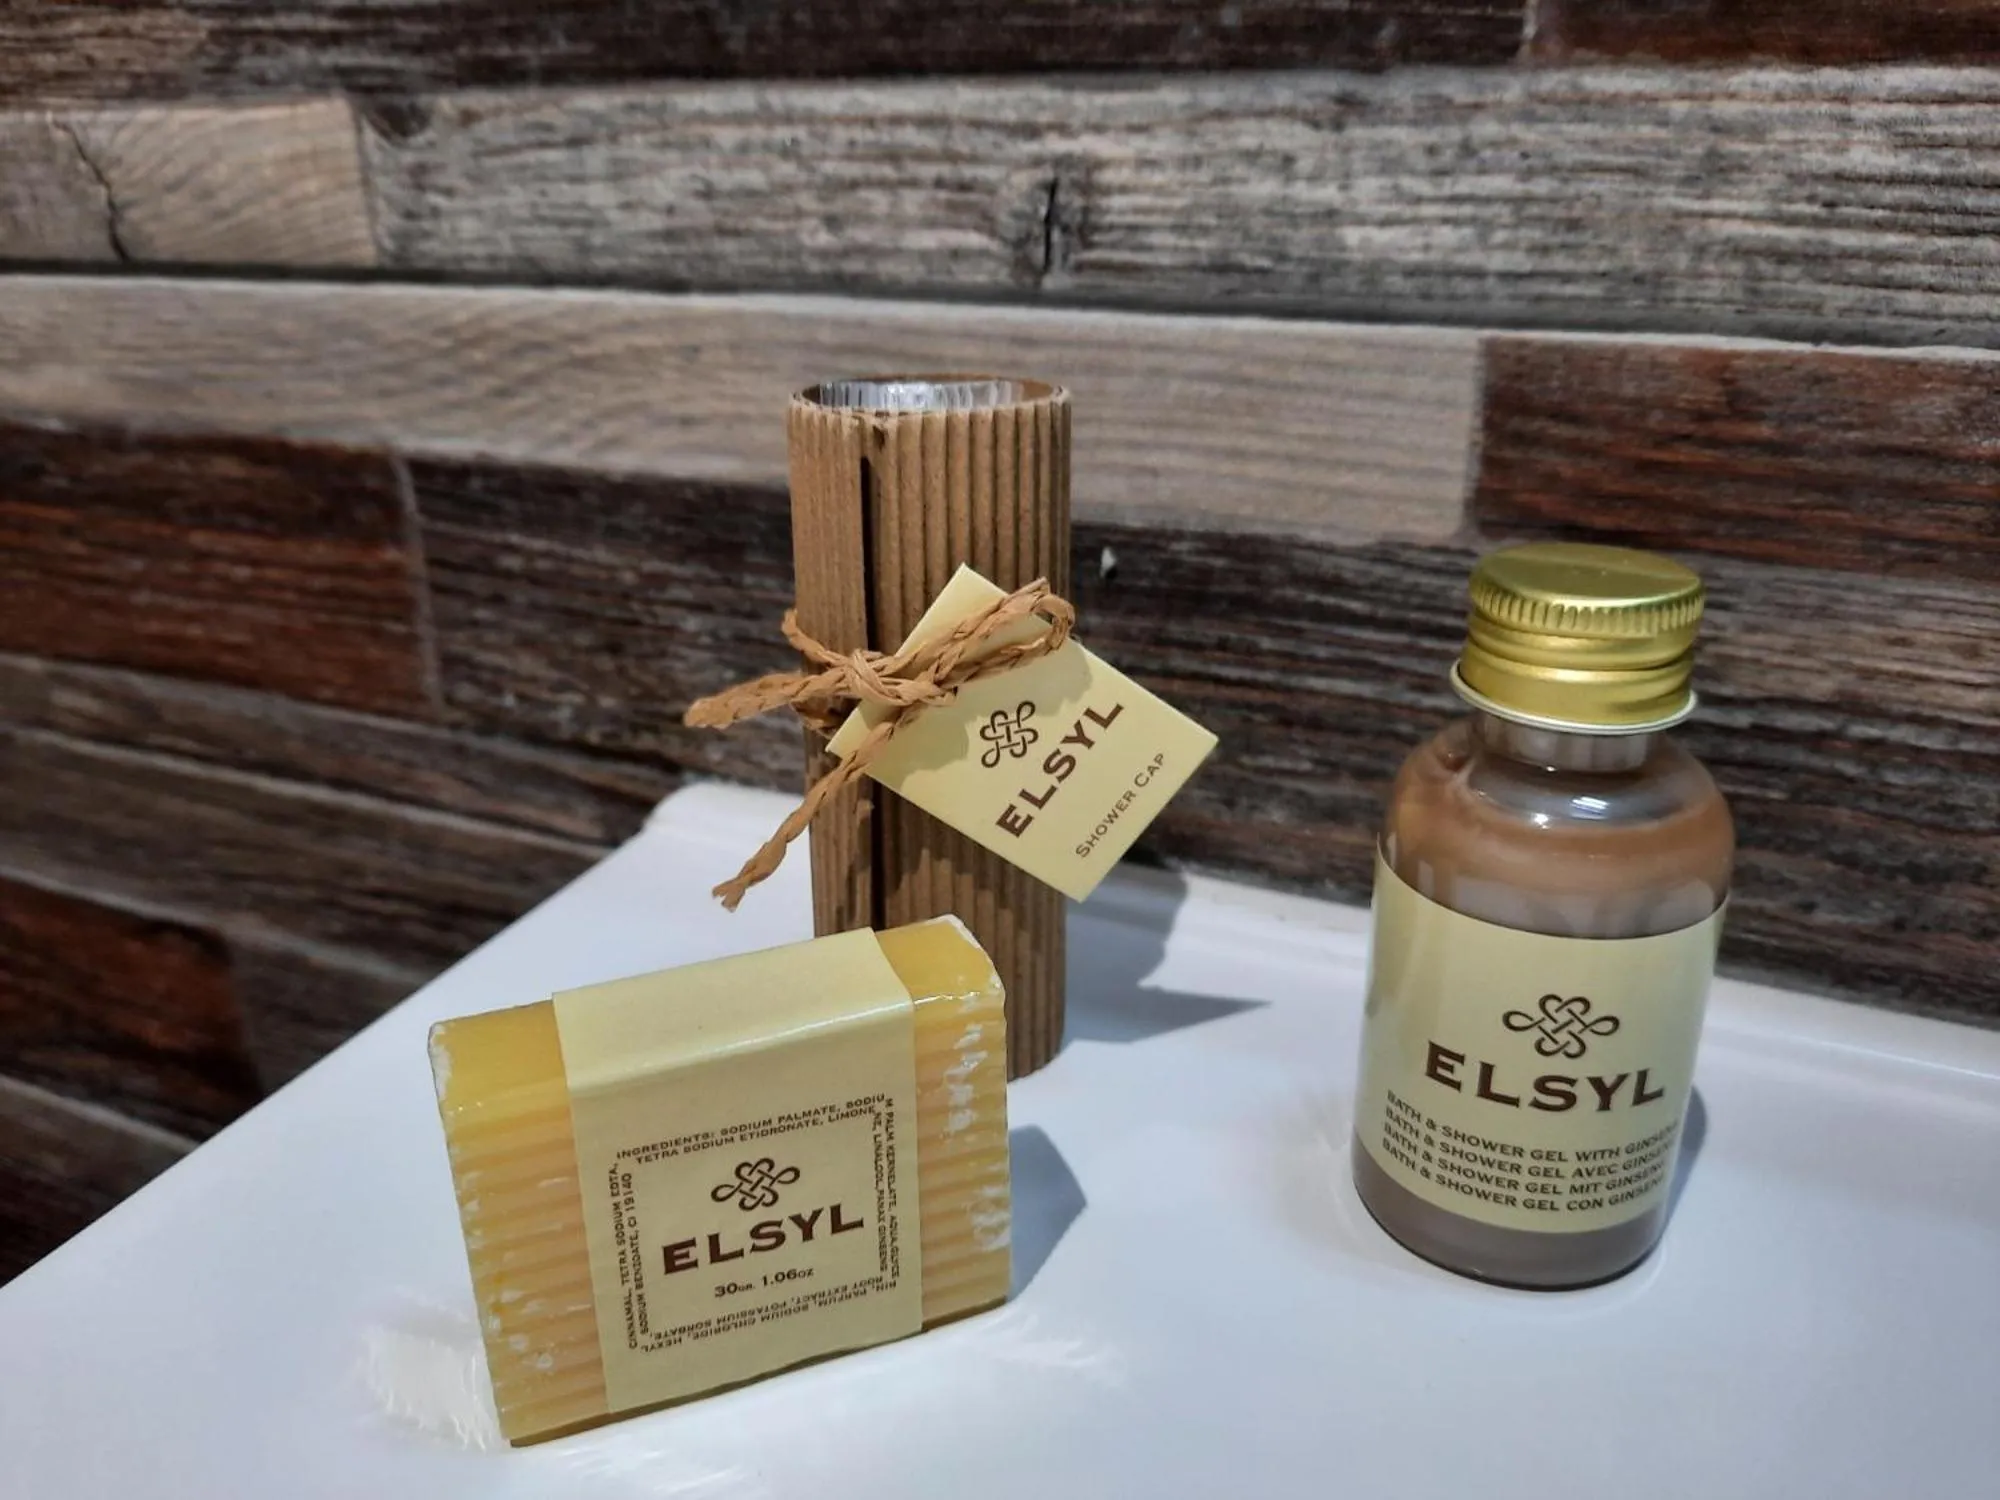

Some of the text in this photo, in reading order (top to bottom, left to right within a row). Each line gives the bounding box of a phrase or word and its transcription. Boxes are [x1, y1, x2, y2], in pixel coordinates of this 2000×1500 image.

[995, 703, 1124, 839] ELSYL
[1075, 752, 1165, 857] SHOWER CAP
[1425, 1040, 1664, 1112] ELSYL
[617, 1131, 714, 1159] INGREDIENTS:
[720, 1118, 772, 1136] SODIUM
[778, 1104, 841, 1124] PALMATE,
[636, 1149, 679, 1164] TETRA
[683, 1136, 734, 1154] SODIUM
[885, 1111, 894, 1142] PALM
[1386, 1104, 1419, 1139] BATH
[1423, 1133, 1435, 1147] &
[1439, 1141, 1522, 1175] SHOWER
[1527, 1165, 1566, 1179] GEL
[1572, 1163, 1619, 1178] AVEC
[1387, 1089, 1421, 1123] BATH
[1426, 1117, 1437, 1132] &
[1441, 1125, 1525, 1158] SHOWER
[1530, 1148, 1568, 1162] GEL
[1576, 1146, 1620, 1161] WITH
[1382, 1136, 1416, 1171] BATH
[1419, 1165, 1431, 1180] &
[1435, 1172, 1517, 1207] SHOWER
[1522, 1198, 1560, 1212] GEL
[1566, 1198, 1603, 1211] CON
[1384, 1122, 1417, 1154] BATH
[1421, 1149, 1433, 1163] &
[1437, 1157, 1520, 1191] SHOWER
[1525, 1182, 1563, 1196] GEL
[1569, 1182, 1602, 1194] MIT
[621, 1172, 635, 1212] 19140
[613, 1201, 626, 1246] SODIUM
[661, 1203, 865, 1275] ELSYL
[618, 1248, 629, 1287] TETRA
[637, 1293, 648, 1335] SODIUM
[717, 1301, 787, 1325] POTASSIUM
[760, 1303, 809, 1322] SODIUM
